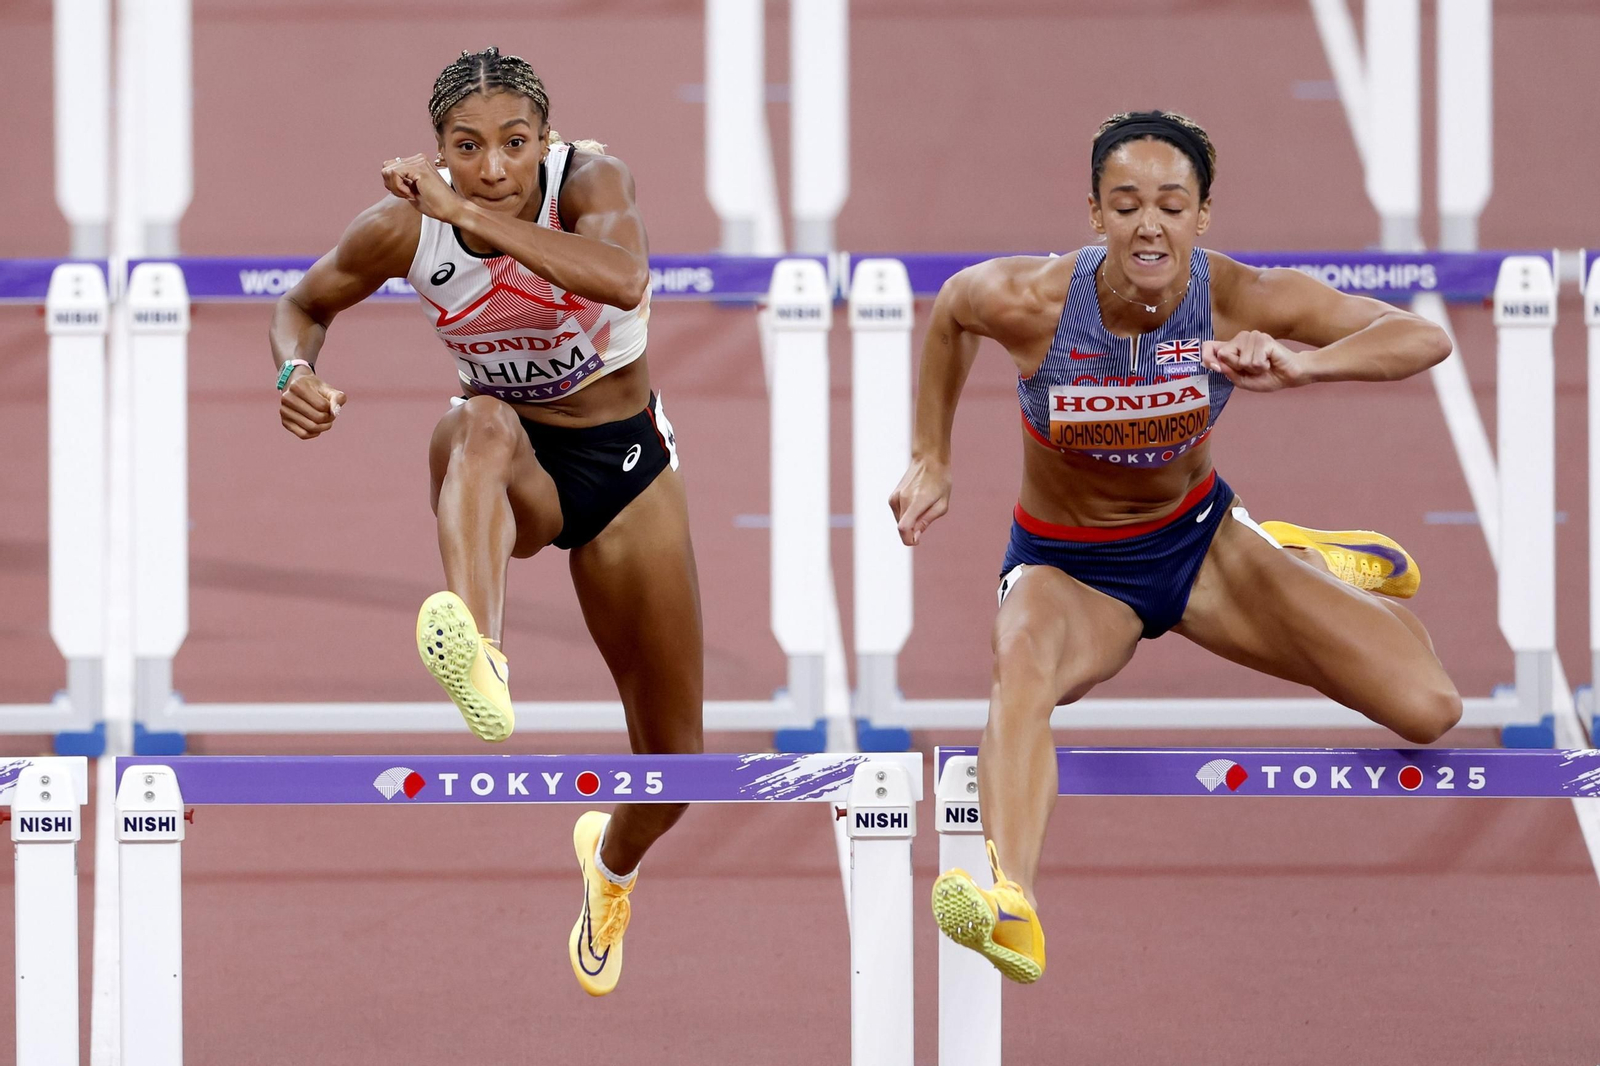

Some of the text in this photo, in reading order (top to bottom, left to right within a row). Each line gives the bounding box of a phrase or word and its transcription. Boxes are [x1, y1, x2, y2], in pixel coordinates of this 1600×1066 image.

[239, 269, 306, 294] WOR
[445, 331, 580, 355] HONDA
[459, 346, 585, 384] THIAM
[1053, 385, 1205, 412] HONDA
[1056, 409, 1205, 446] JOHNSON-THOMPSON
[612, 771, 663, 795] 25
[1436, 766, 1486, 790] 25
[20, 817, 72, 832] NISHI
[124, 817, 176, 832] NISHI
[855, 812, 908, 828] NISHI
[945, 807, 983, 823] NIS
